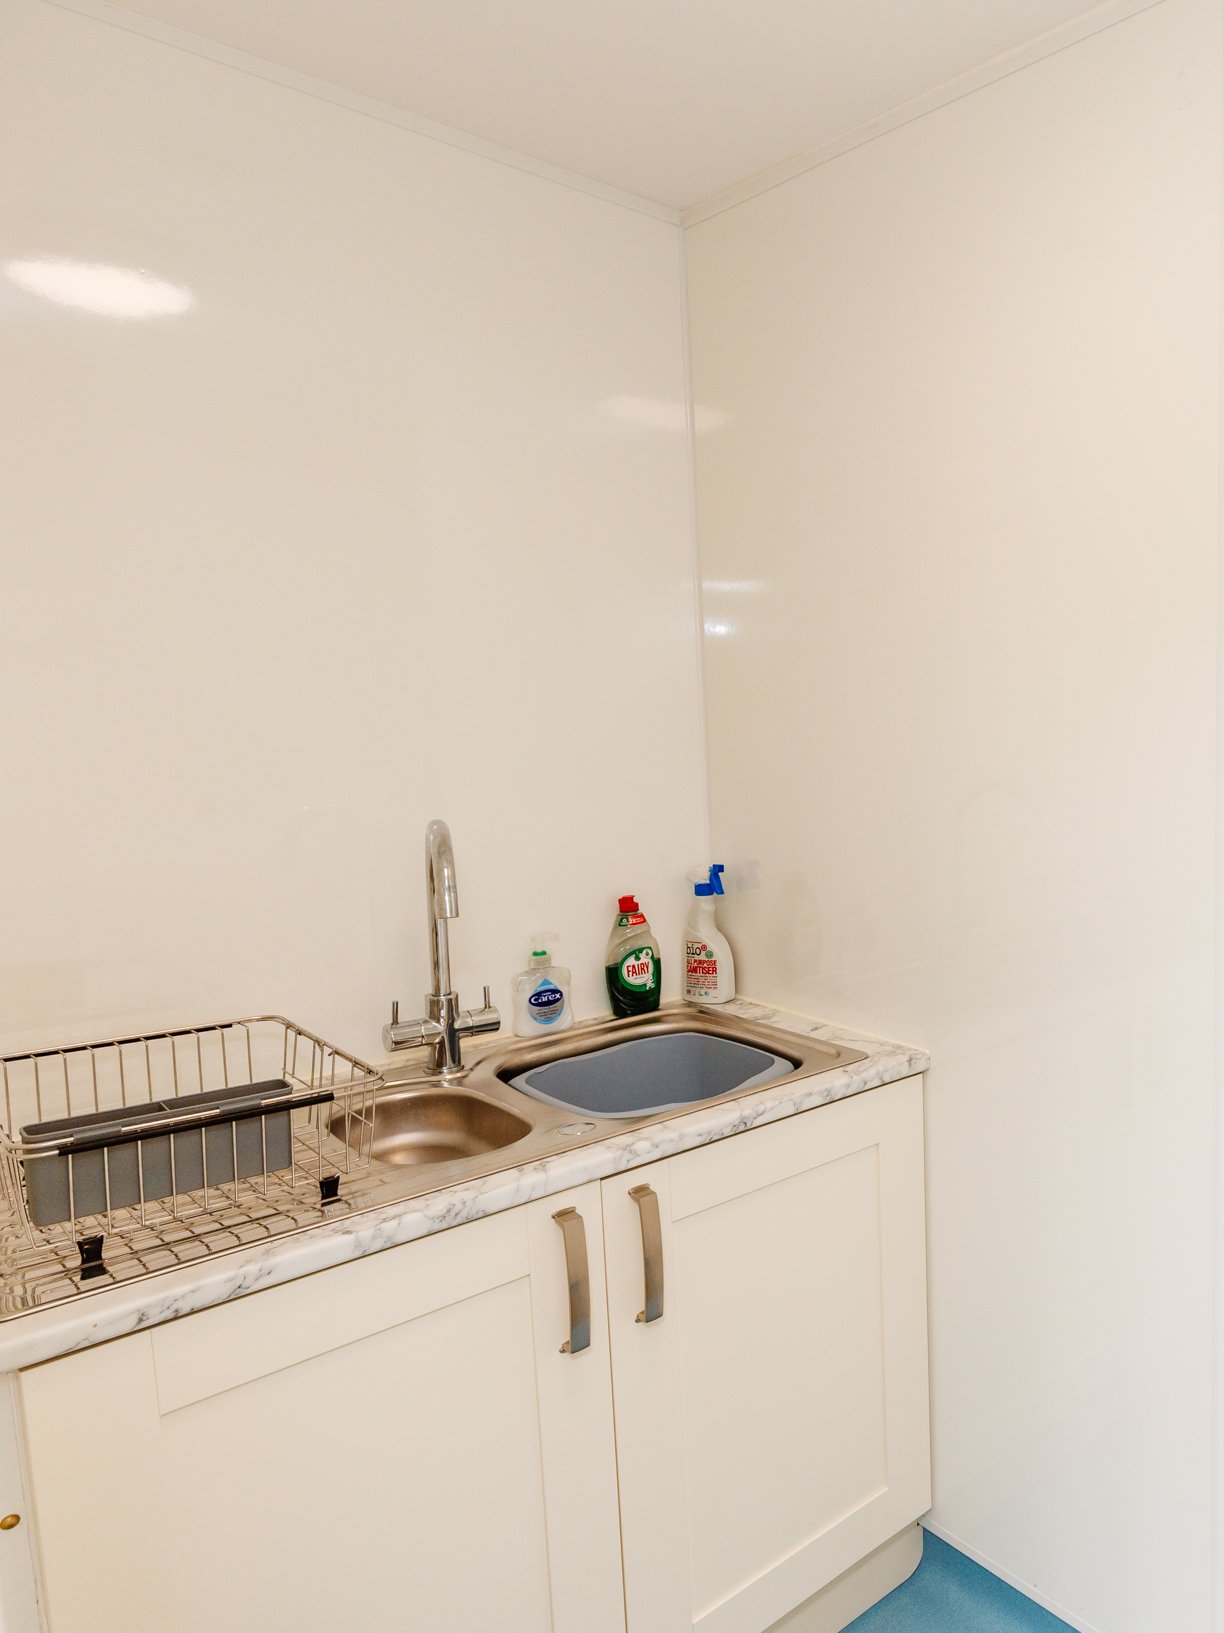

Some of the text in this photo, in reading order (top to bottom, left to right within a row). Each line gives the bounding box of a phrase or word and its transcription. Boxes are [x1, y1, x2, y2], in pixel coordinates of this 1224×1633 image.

[686, 943, 702, 956] bio
[626, 961, 650, 977] FAIRY
[694, 959, 717, 967] PURPOSE
[686, 965, 717, 975] SANITISER
[530, 992, 561, 1004] Carex
